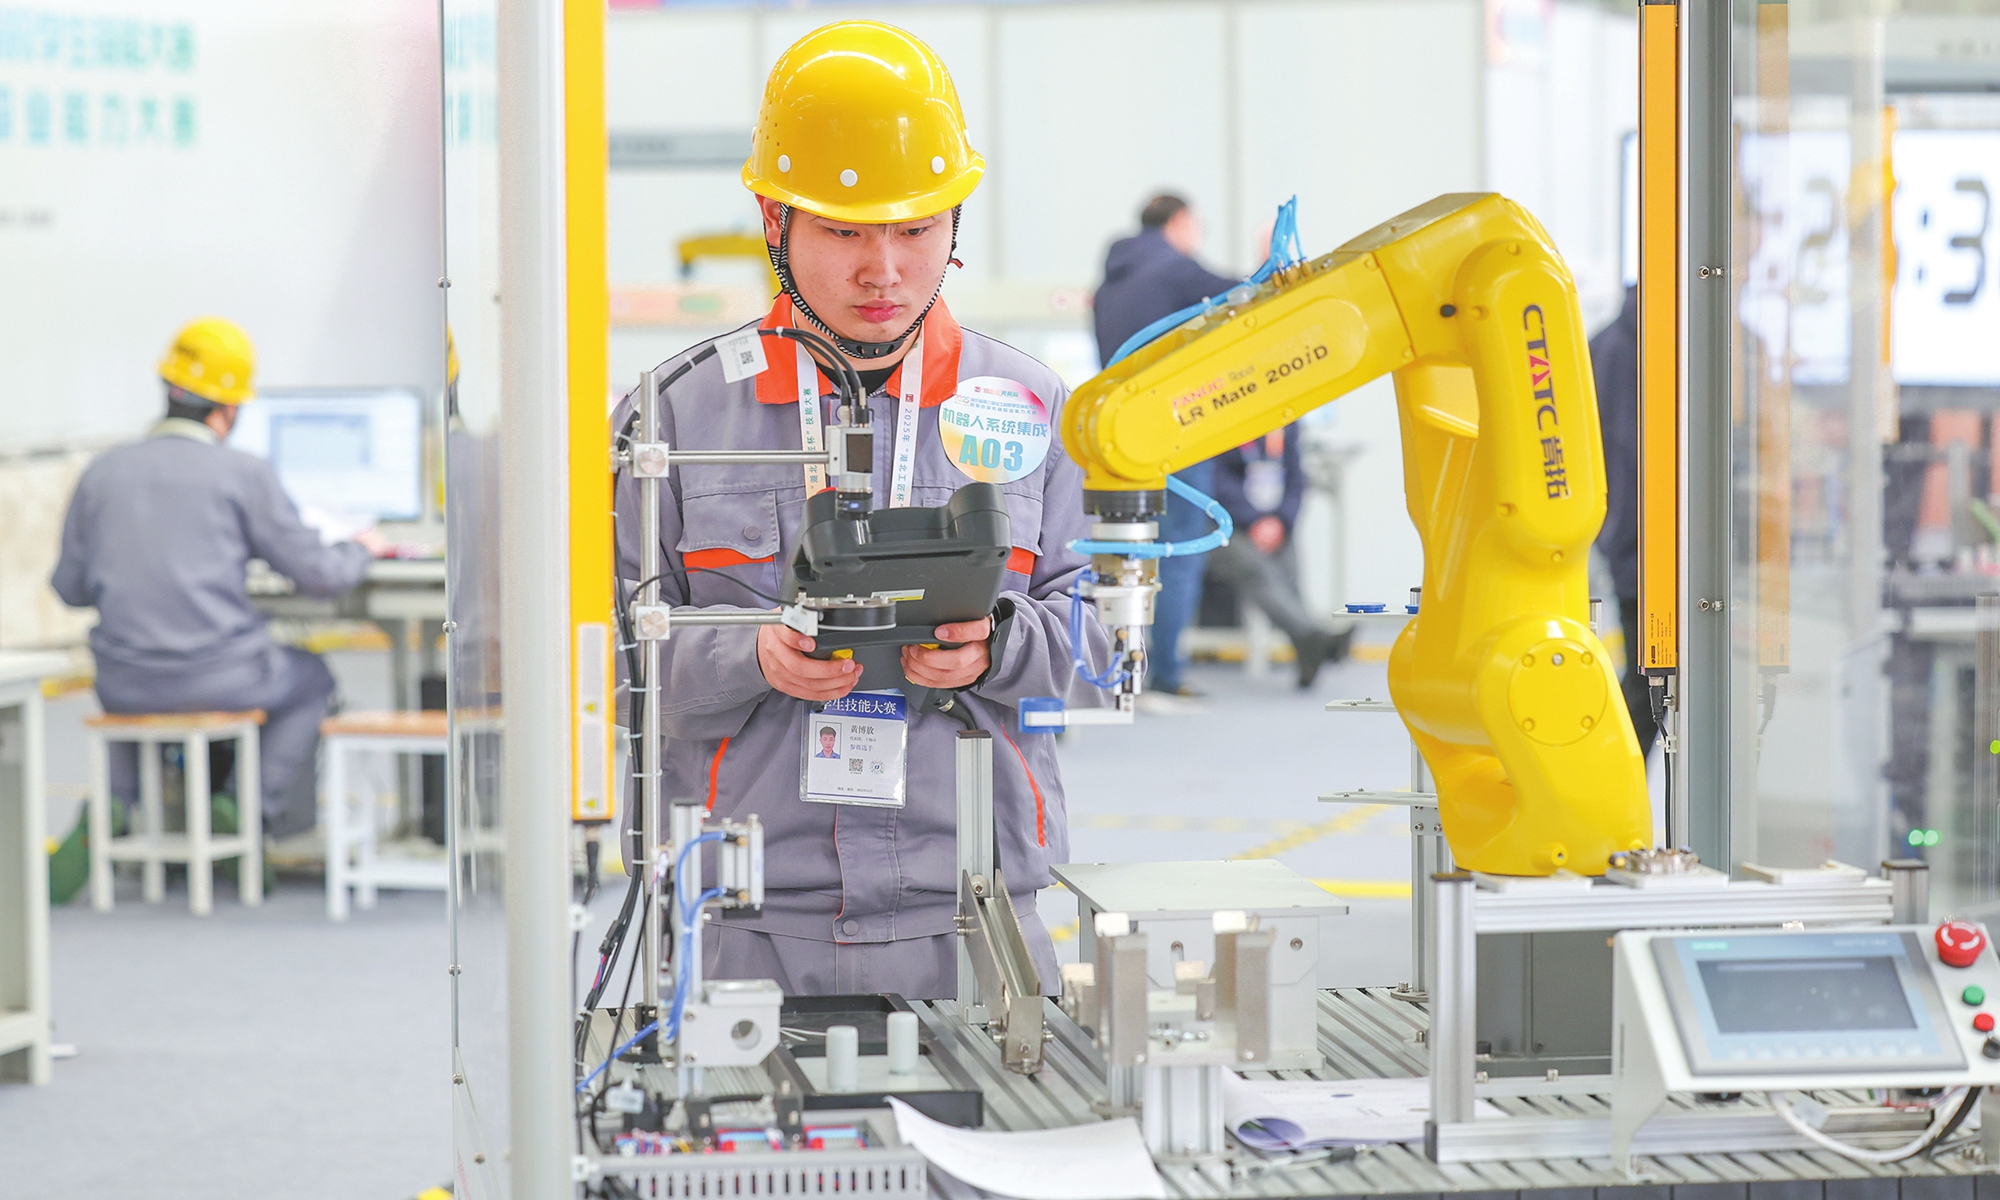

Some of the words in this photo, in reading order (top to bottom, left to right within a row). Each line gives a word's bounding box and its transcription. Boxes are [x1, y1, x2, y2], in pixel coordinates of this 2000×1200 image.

[1172, 377, 1226, 409] FANUC
[1178, 405, 1205, 427] LR
[1212, 382, 1259, 411] Mate
[1265, 345, 1329, 385] 200iD
[1523, 304, 1559, 431] CTATC
[942, 407, 1048, 438] 机器人系统集成
[958, 433, 1024, 472] A03
[1541, 436, 1569, 500] 肯拓
